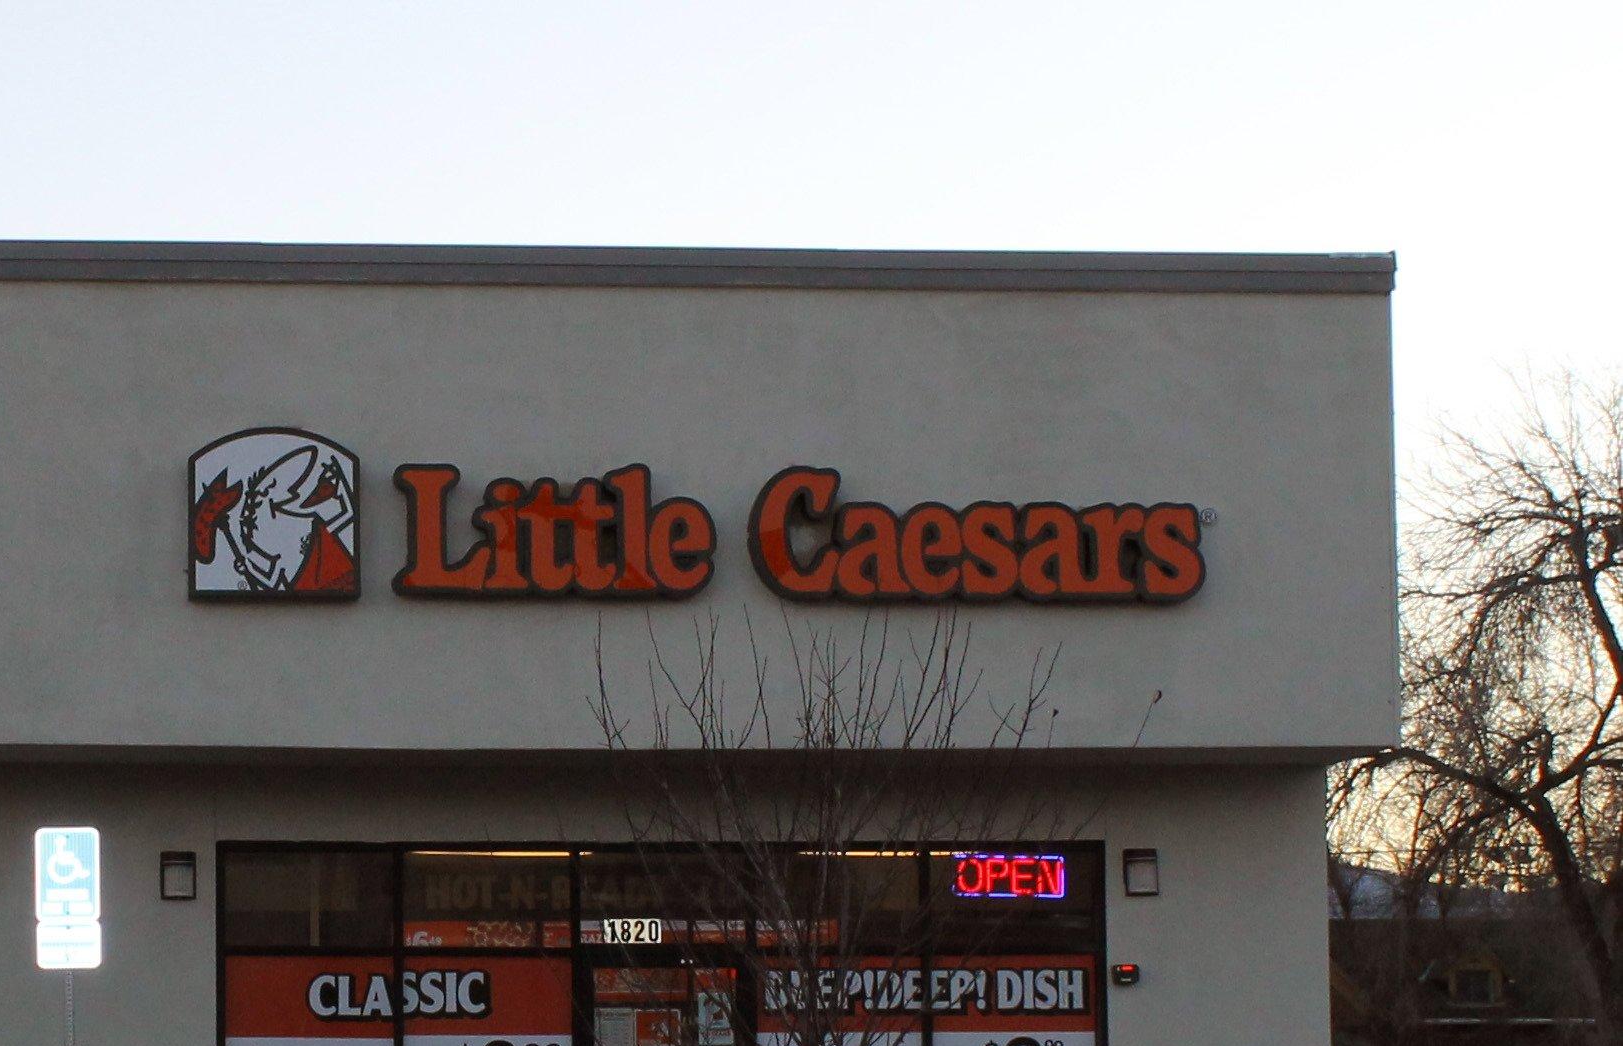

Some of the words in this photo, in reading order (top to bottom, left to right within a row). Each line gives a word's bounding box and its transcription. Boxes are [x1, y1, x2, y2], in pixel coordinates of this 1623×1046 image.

[393, 464, 715, 599] Little
[747, 465, 1205, 602] Caesars
[957, 857, 1064, 895] OPEN
[607, 919, 660, 943] 1820
[308, 971, 488, 1018] CLASSIC
[995, 968, 1085, 1011] DISH
